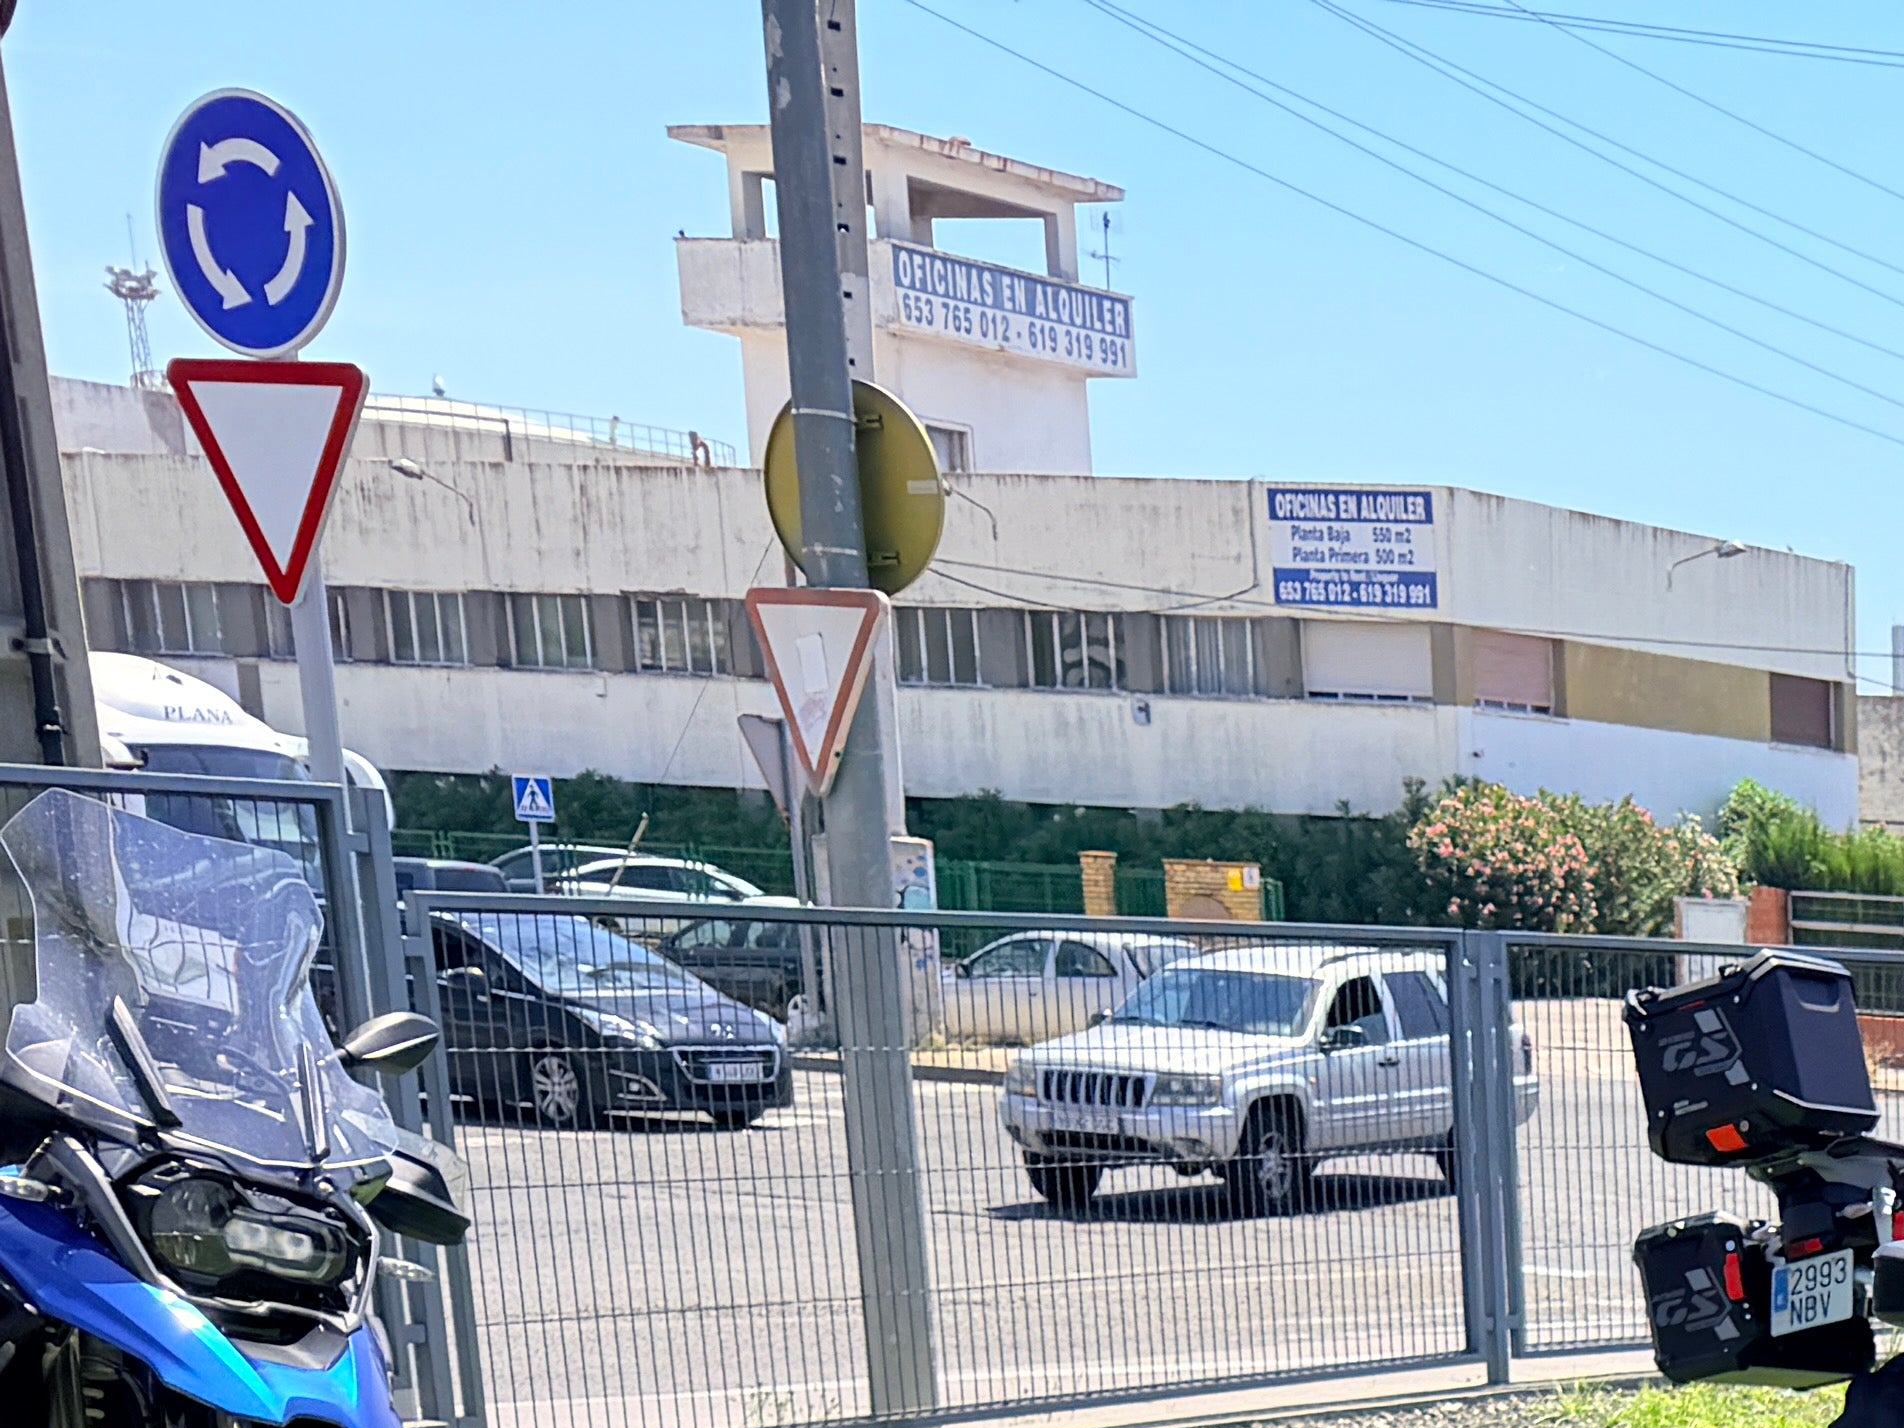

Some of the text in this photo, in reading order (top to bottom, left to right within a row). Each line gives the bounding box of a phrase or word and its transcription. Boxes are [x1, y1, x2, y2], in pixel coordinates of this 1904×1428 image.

[899, 250, 1127, 335] OFICINAS EN ALQUILER
[903, 292, 934, 326] 653
[941, 302, 972, 335] 765
[980, 310, 1010, 343] 012
[1028, 321, 1058, 353] 619
[1064, 329, 1094, 361] 319
[1100, 336, 1127, 369] 991
[1275, 493, 1426, 521] OFICINAS EN ALQUILER
[1291, 525, 1324, 542] Planta
[1327, 526, 1350, 545] Baja
[1292, 547, 1325, 562] Planta
[1329, 547, 1369, 565] Primera
[1279, 581, 1301, 600] 653
[1304, 582, 1326, 601] 765
[1328, 583, 1351, 602] 012
[1359, 583, 1382, 603] 619
[1384, 584, 1406, 603] 319
[1409, 585, 1431, 604] 991
[164, 706, 233, 725] PLANA
[1790, 1257, 1847, 1296] 2993
[1790, 1291, 1831, 1326] NBV
